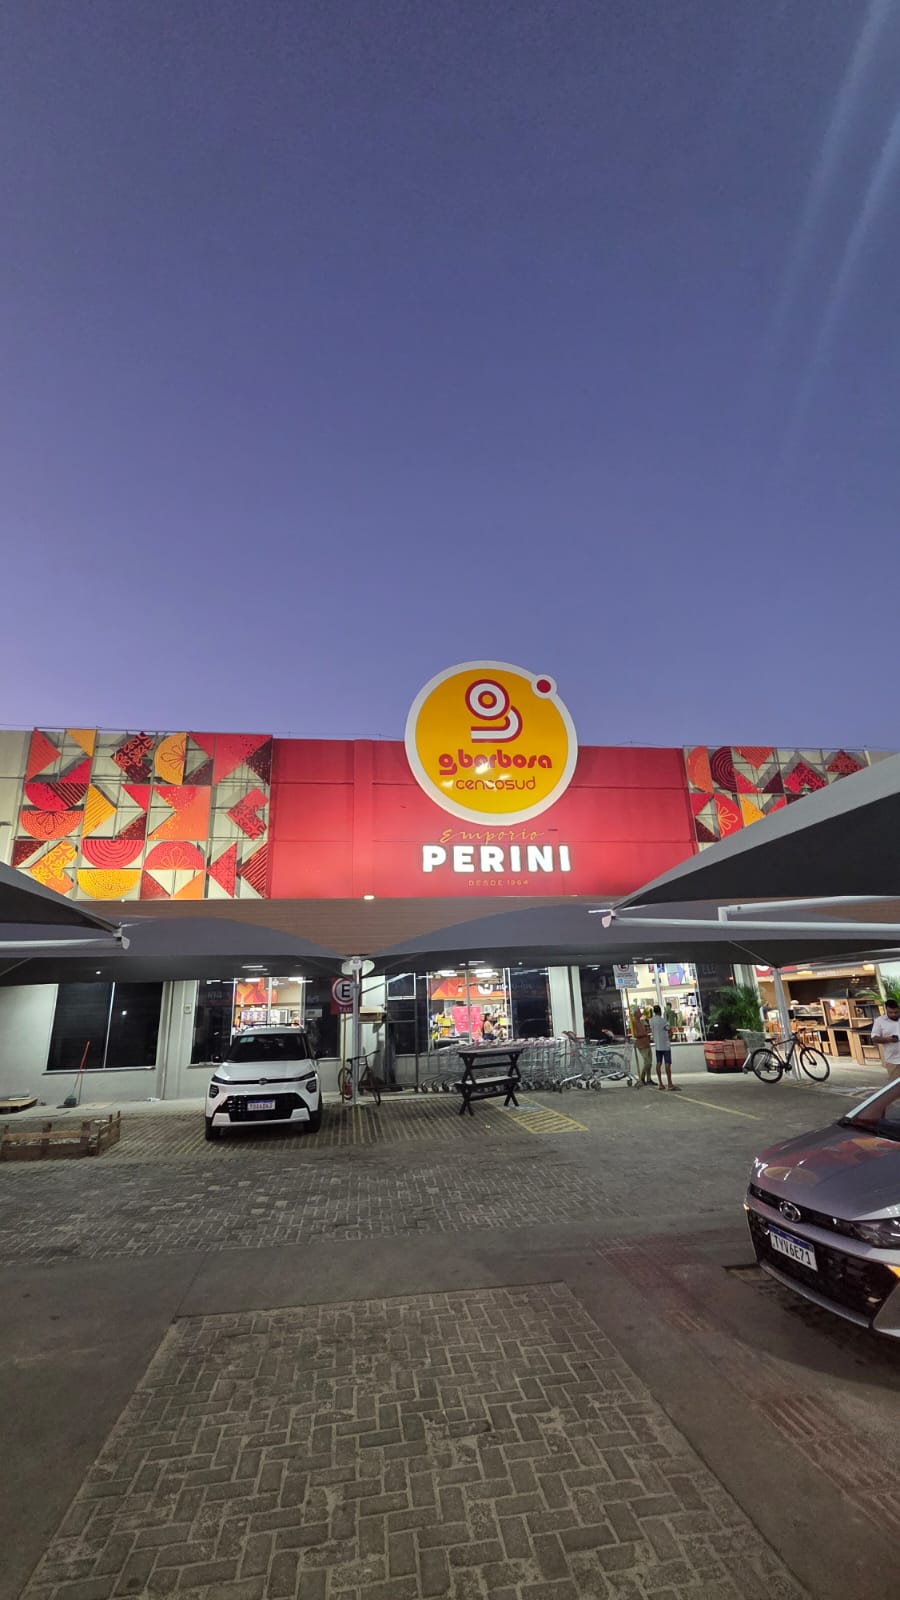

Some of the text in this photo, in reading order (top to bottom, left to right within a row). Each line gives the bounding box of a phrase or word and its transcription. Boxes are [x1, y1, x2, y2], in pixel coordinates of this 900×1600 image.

[455, 776, 536, 790] cencosud
[422, 845, 571, 873] PERINI
[468, 879, 504, 887] DESDE
[341, 984, 351, 998] E
